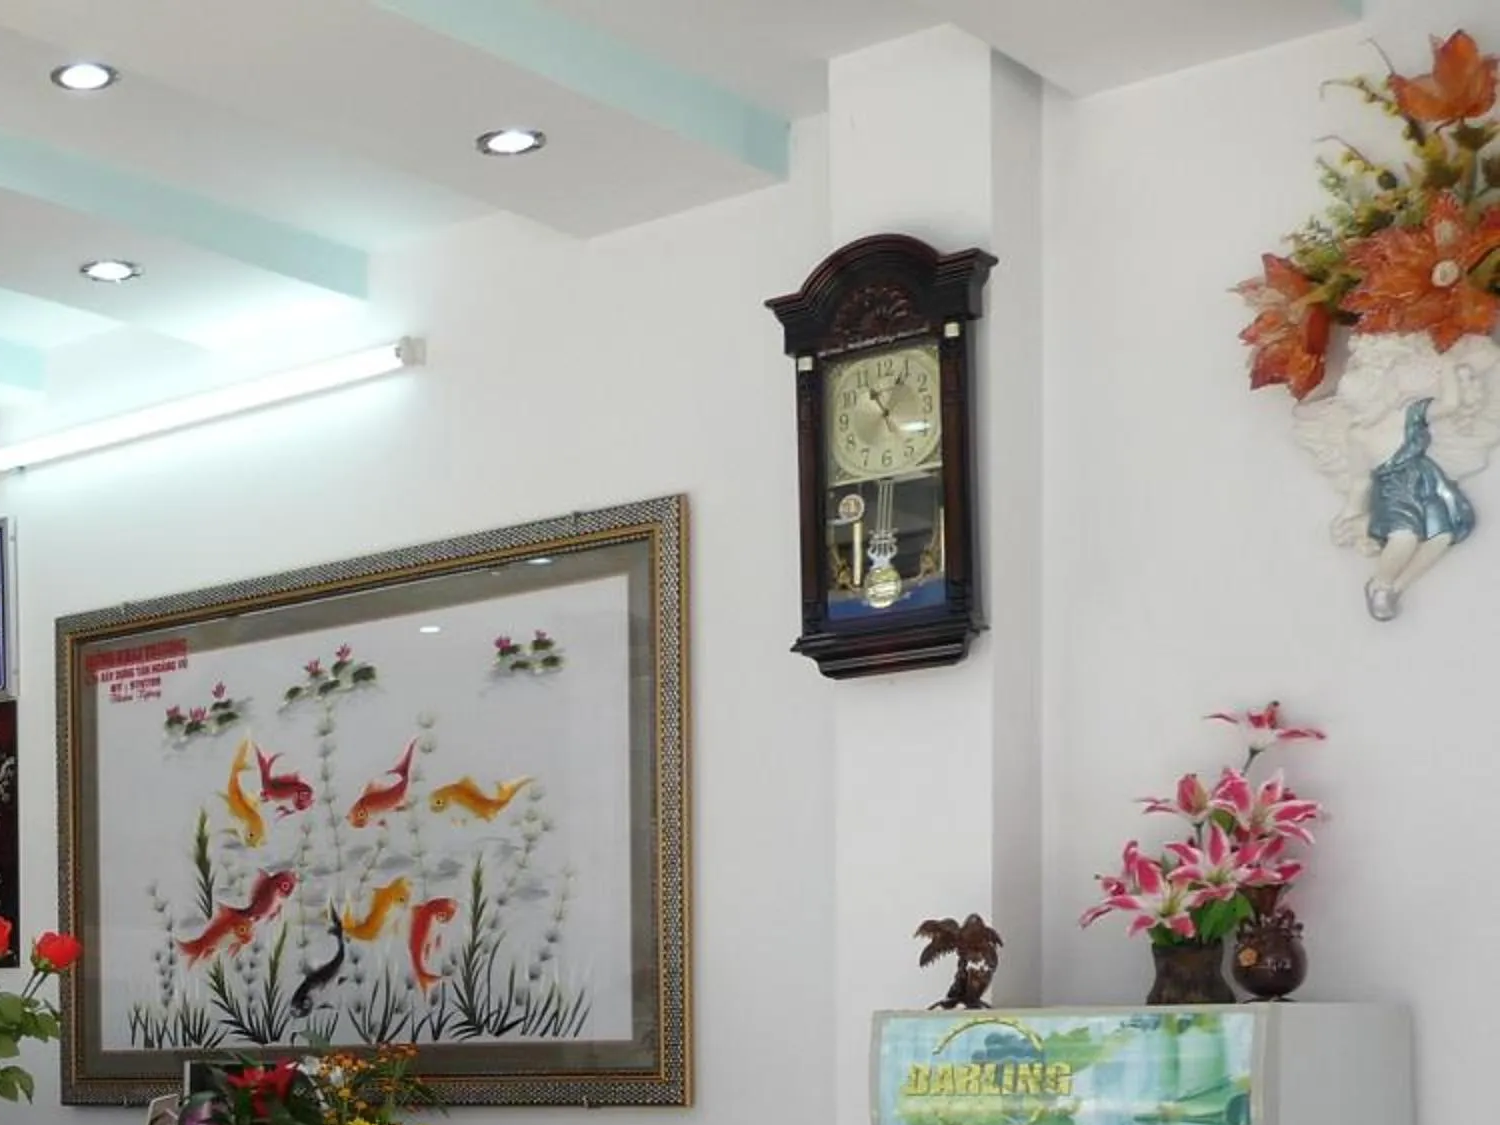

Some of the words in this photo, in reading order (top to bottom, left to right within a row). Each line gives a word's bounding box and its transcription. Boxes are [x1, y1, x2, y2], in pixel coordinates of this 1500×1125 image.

[856, 368, 869, 389] 11
[876, 359, 894, 379] 12
[916, 372, 928, 393] 2
[842, 389, 857, 409] 10
[923, 395, 933, 414] 3
[839, 413, 849, 434] 9
[845, 432, 857, 453] 8
[903, 438, 915, 458] 5
[861, 447, 870, 467] 7
[881, 449, 893, 468] 6
[905, 1061, 1074, 1097] DARLING
